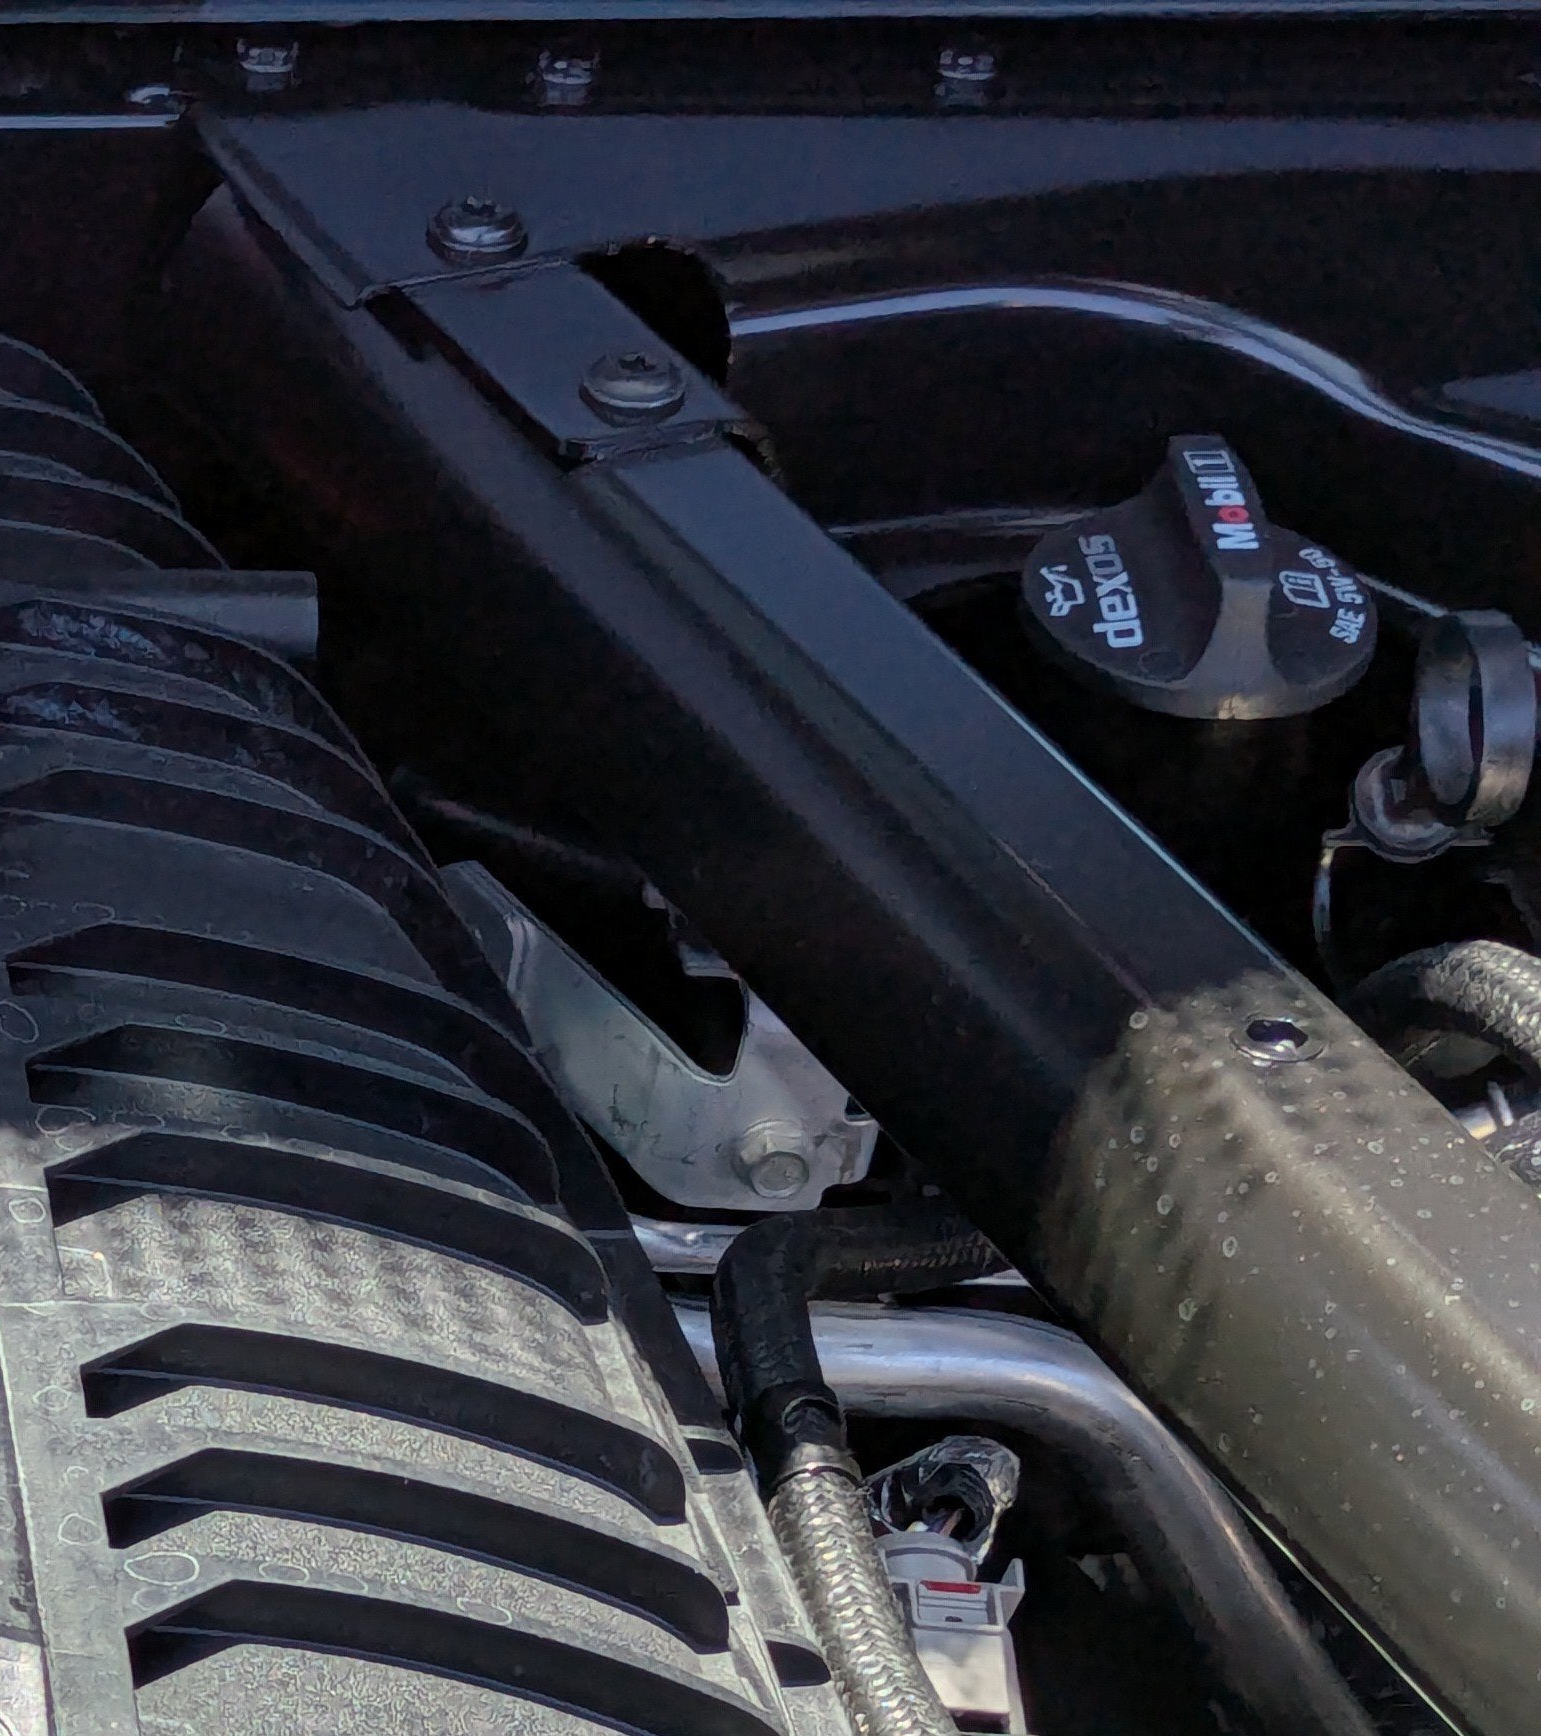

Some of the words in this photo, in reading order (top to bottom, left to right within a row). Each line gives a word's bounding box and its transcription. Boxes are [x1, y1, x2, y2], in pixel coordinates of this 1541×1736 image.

[1197, 476, 1259, 550] Mobil
[1078, 534, 1144, 648] dexos
[1329, 608, 1365, 644] SAE
